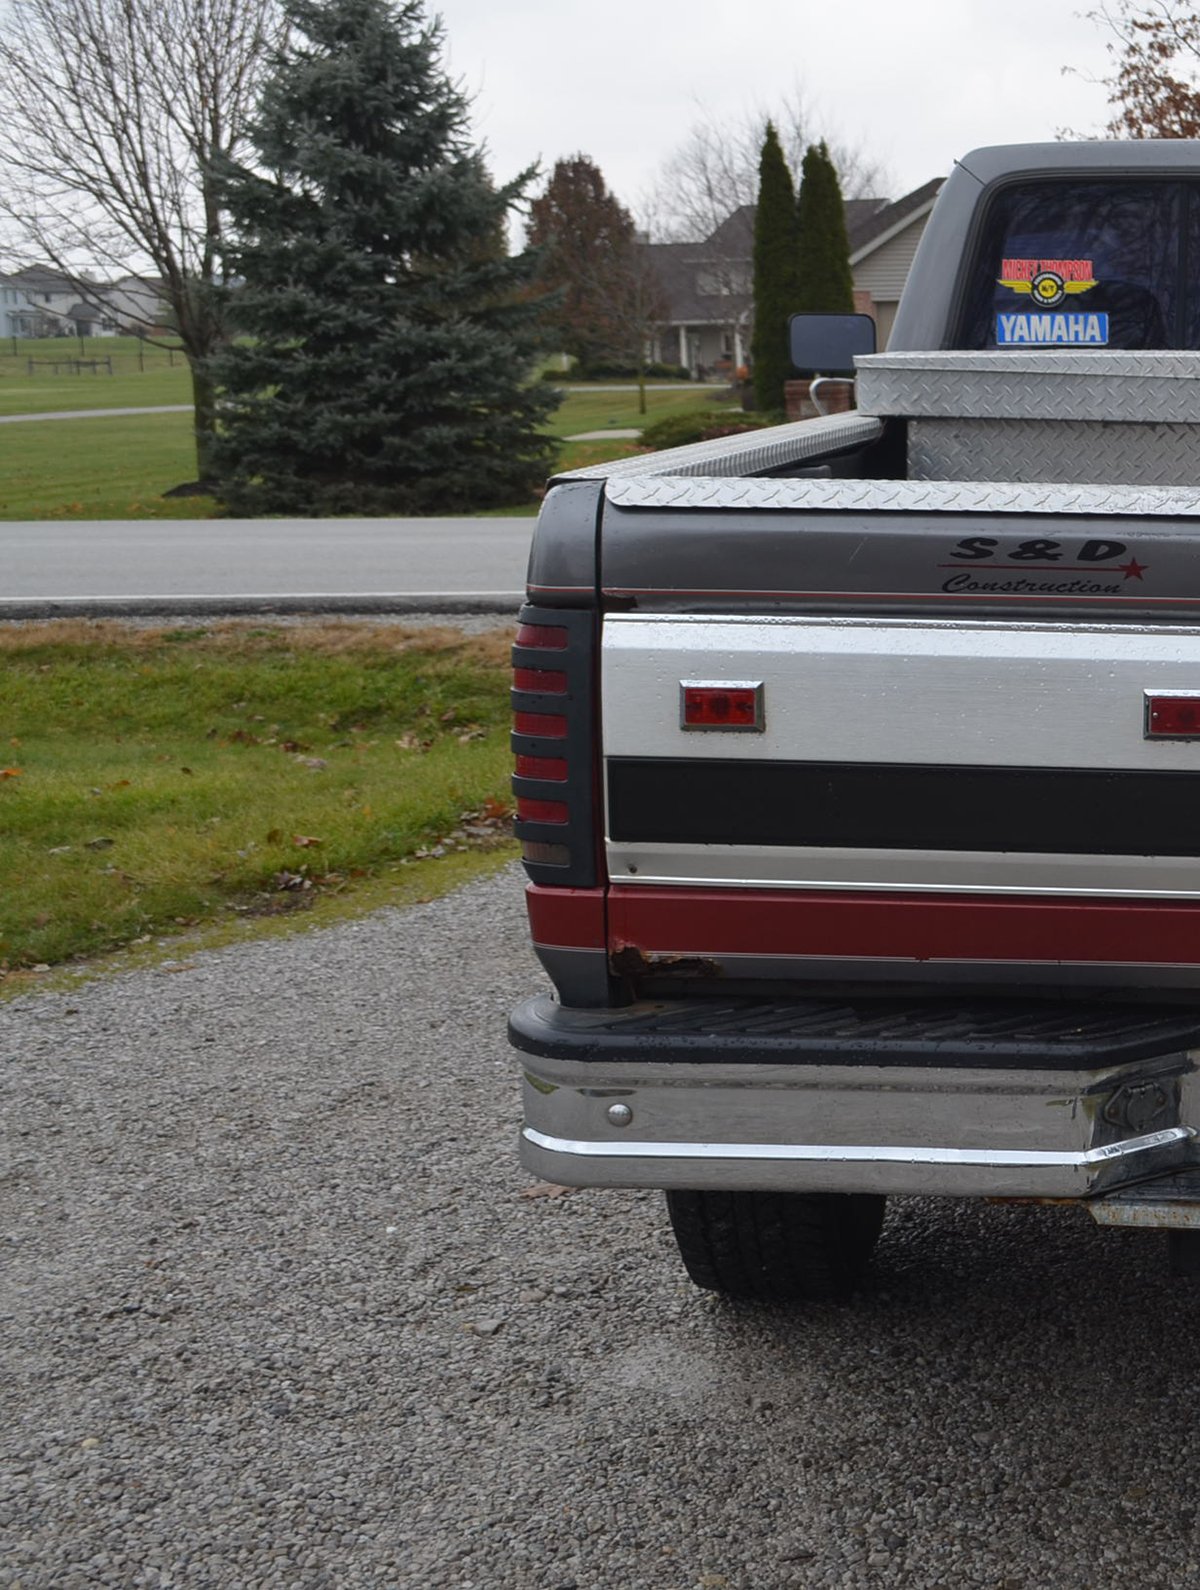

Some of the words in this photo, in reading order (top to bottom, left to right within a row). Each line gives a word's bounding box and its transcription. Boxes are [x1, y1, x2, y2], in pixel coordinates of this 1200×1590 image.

[1001, 315, 1102, 341] YAMAHA
[950, 537, 998, 559] S
[1007, 539, 1063, 561] &
[1076, 539, 1127, 561] D
[942, 573, 1121, 593] Construction
